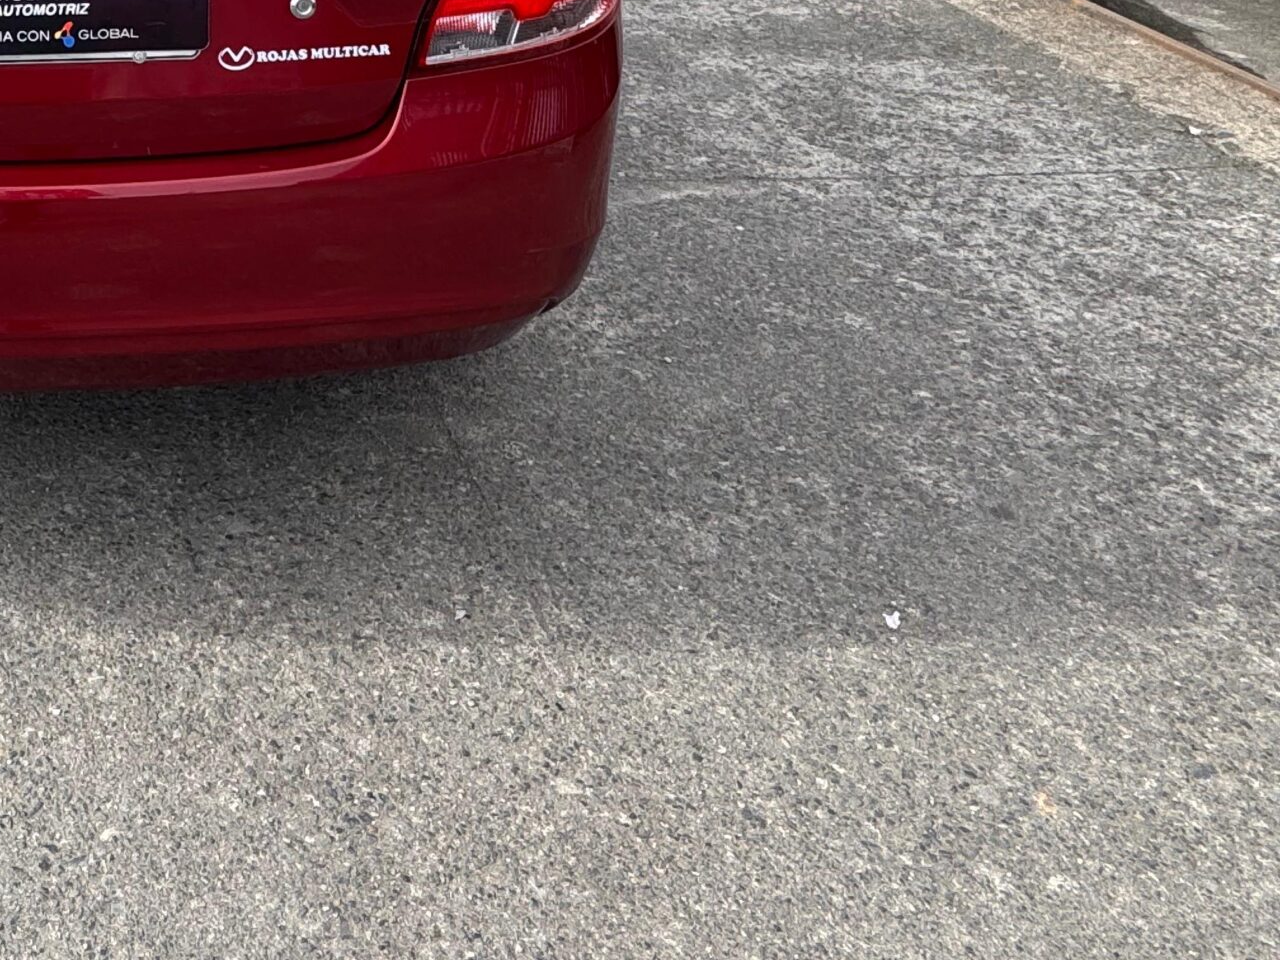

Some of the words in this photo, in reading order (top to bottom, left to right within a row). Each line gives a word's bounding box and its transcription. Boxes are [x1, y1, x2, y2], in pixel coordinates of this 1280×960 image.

[16, 30, 50, 42] CON
[78, 28, 139, 40] GLOBAL
[256, 49, 308, 63] ROJAS
[310, 43, 391, 60] MULTICAR
